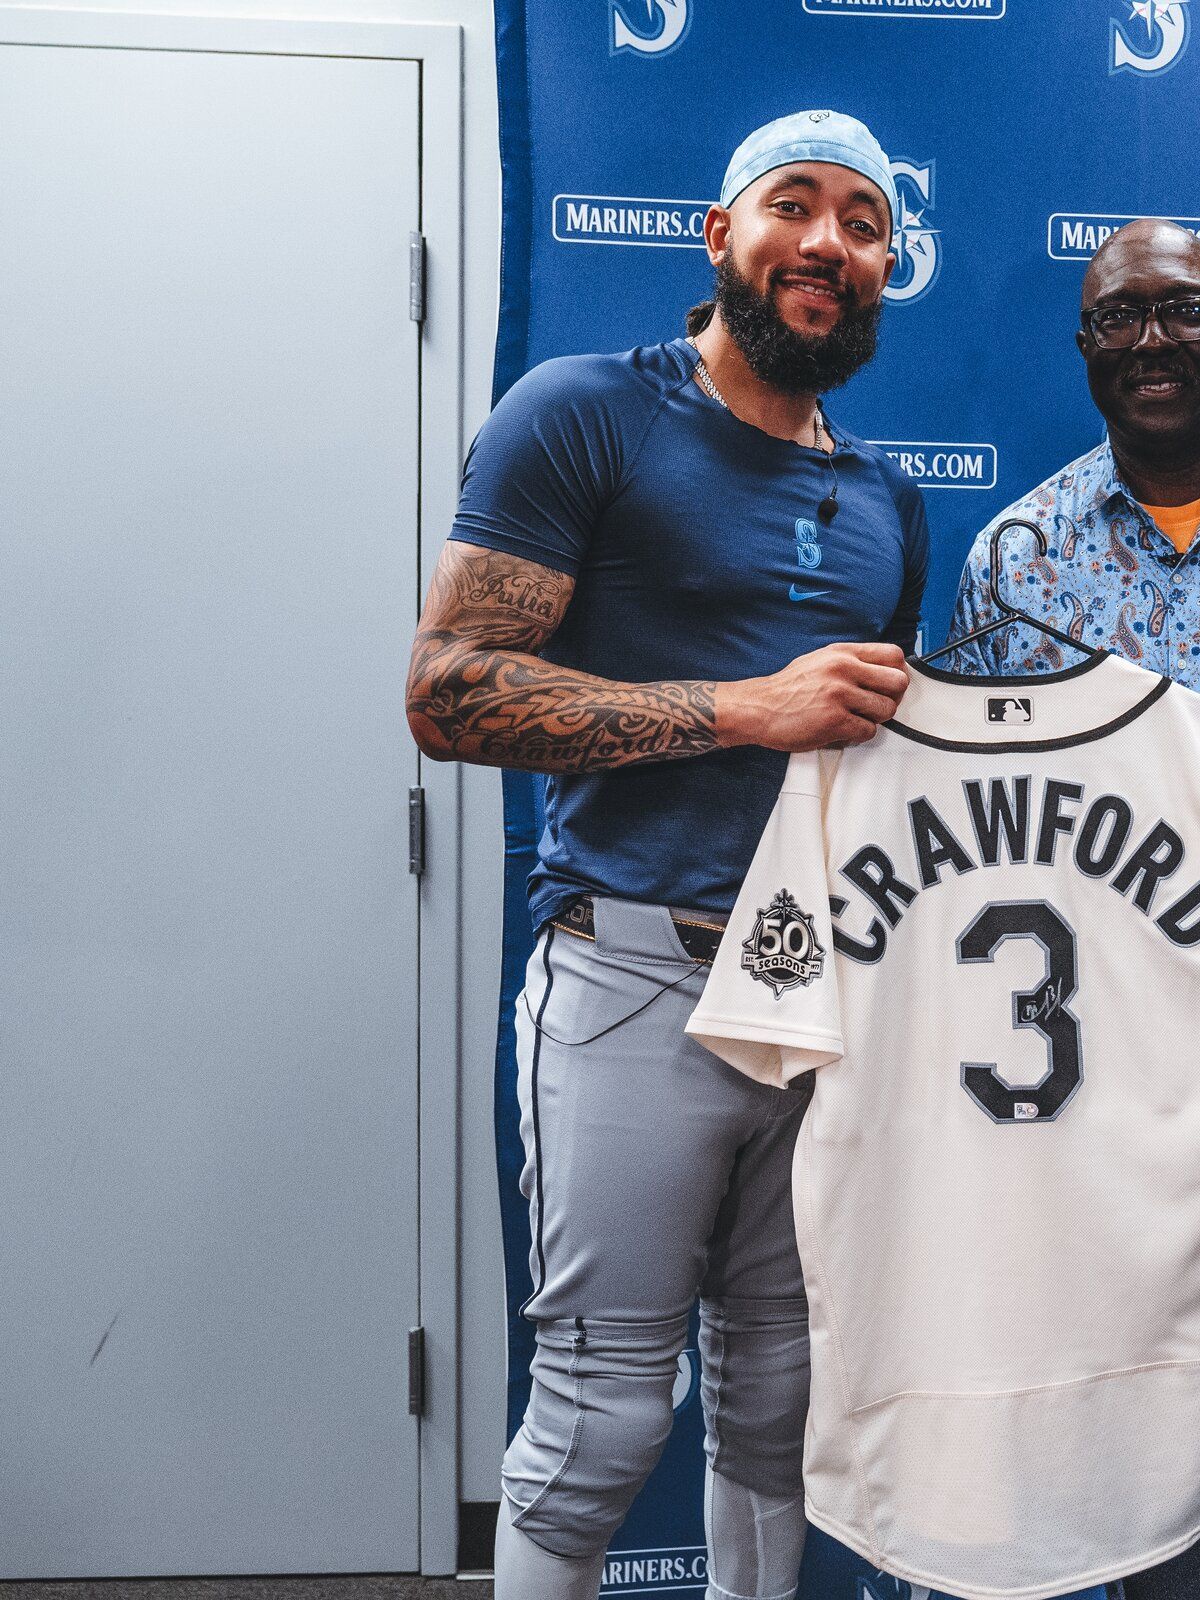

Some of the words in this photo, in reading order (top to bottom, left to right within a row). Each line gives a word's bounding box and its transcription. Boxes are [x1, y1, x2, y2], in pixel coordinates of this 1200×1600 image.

[566, 203, 704, 237] MARINERS.C
[760, 918, 809, 960] 50
[758, 957, 806, 975] seasons
[955, 899, 1084, 1125] 3
